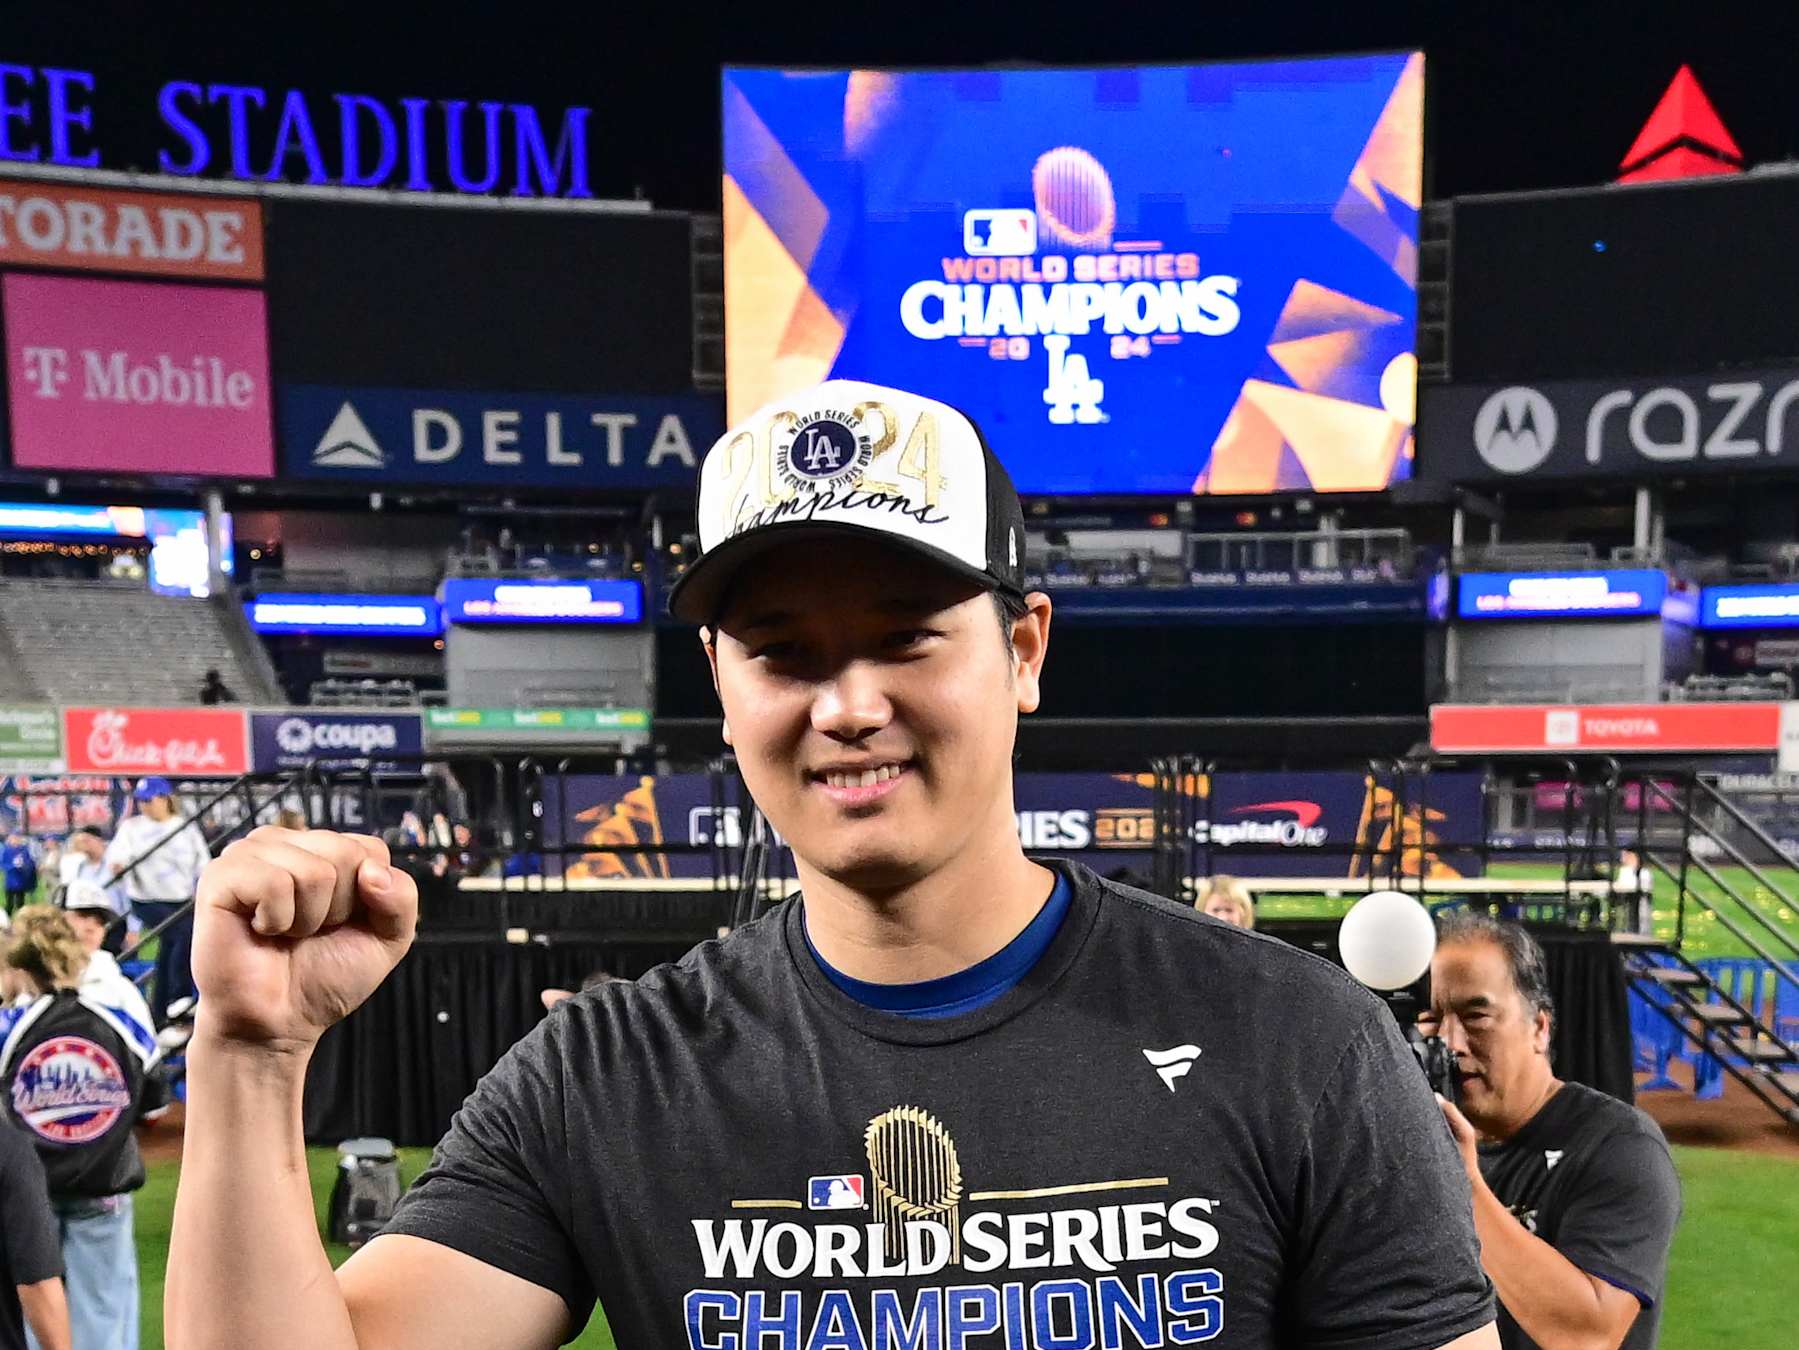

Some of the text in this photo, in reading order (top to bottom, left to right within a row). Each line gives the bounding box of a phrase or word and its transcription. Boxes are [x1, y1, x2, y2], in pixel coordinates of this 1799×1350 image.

[157, 81, 594, 198] STADIUM
[941, 252, 1200, 283] WORLD SERIES
[899, 274, 1241, 340] CHAMPIONS
[987, 335, 1152, 361] 20 24
[81, 350, 254, 409] Mobile
[1042, 334, 1104, 425] LA
[411, 408, 698, 466] DELTA
[788, 409, 861, 436] WORLD SERIES
[1585, 379, 1799, 465] razr
[804, 428, 841, 470] LA
[313, 723, 397, 754] coupa
[1583, 718, 1660, 737] TOYOTA
[1015, 810, 1091, 849] IES
[691, 1198, 1219, 1278] WORLD SERIES
